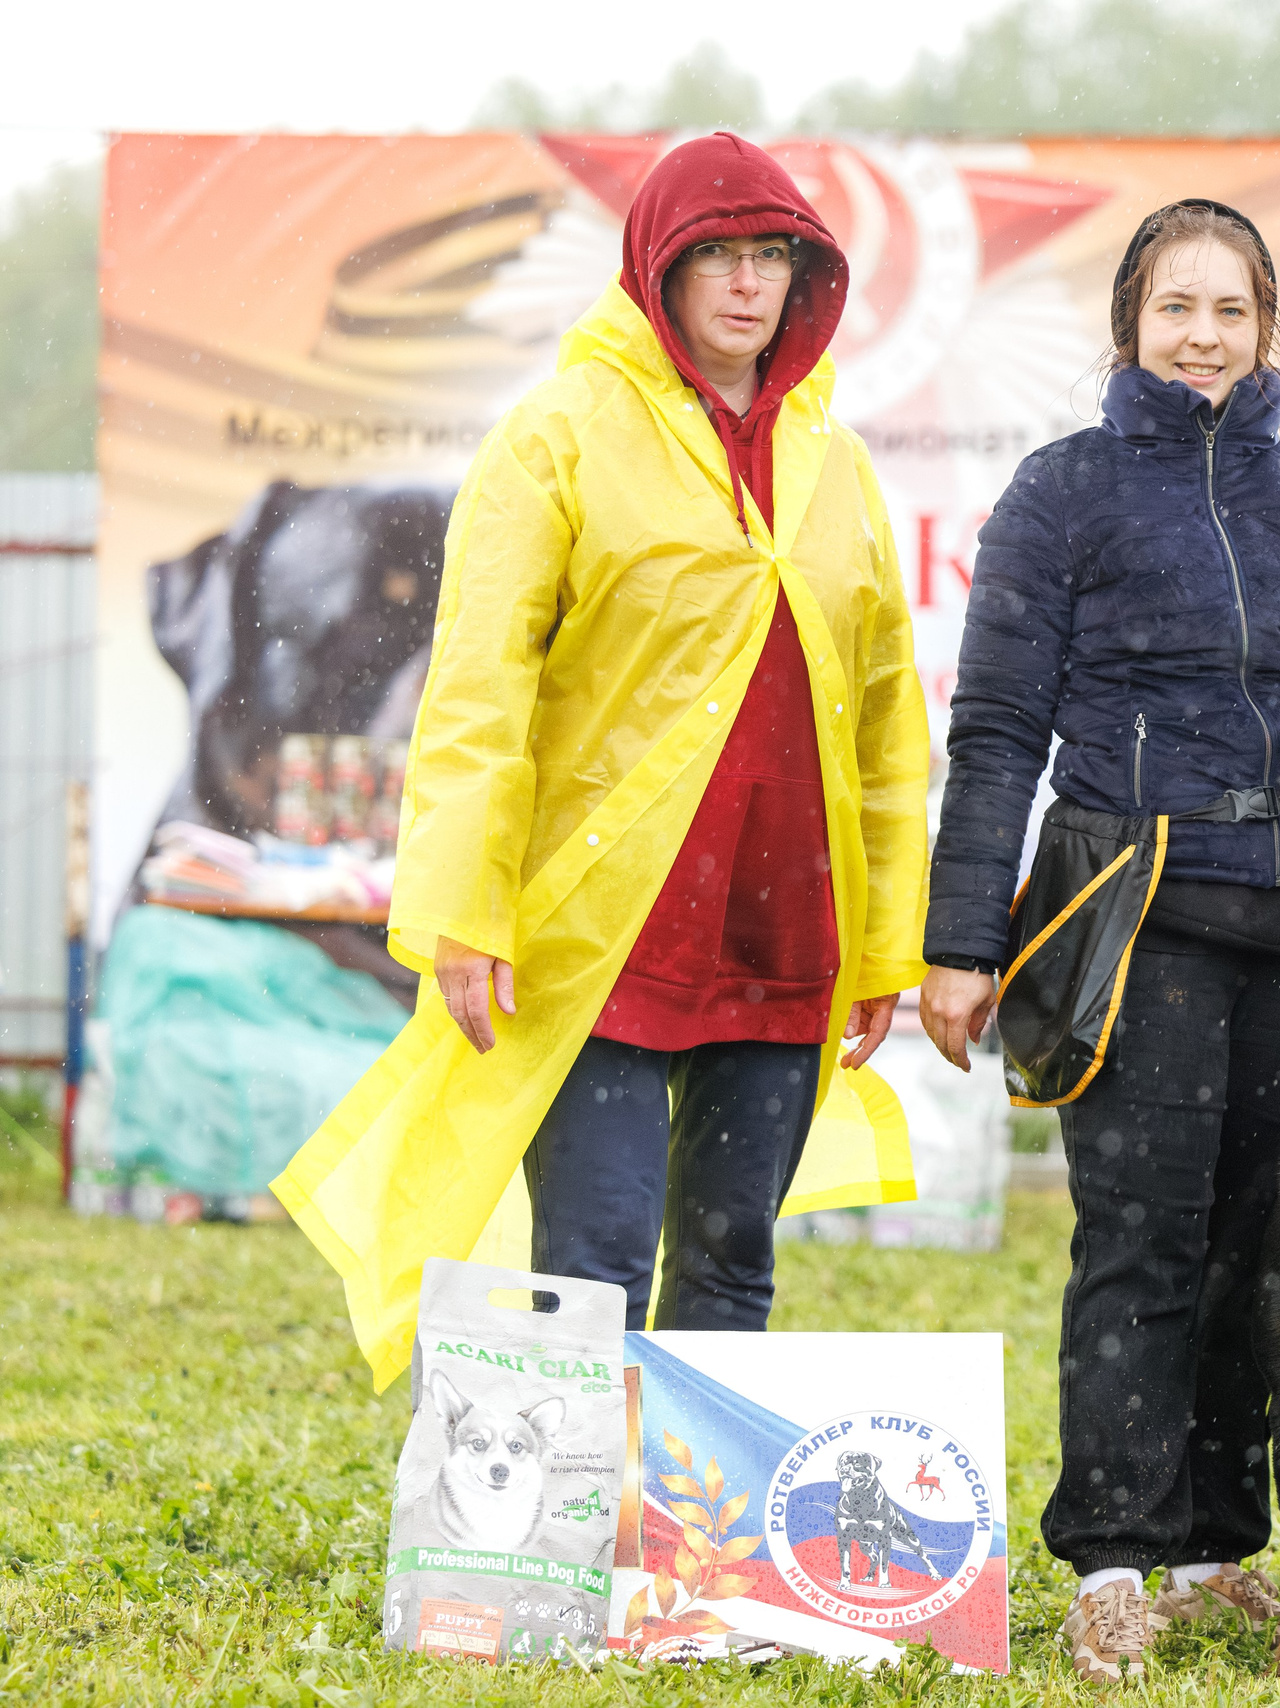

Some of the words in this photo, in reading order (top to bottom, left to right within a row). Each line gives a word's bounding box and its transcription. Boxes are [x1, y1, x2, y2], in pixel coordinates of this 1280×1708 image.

[434, 1341, 525, 1373] ACARI
[538, 1359, 612, 1381] CIAR
[580, 1381, 612, 1393] eco
[770, 1420, 854, 1532] РОТВЕЙЛЕР
[870, 1416, 934, 1440] КЛУБ
[942, 1441, 991, 1532] РОССИИ
[551, 1507, 589, 1519] organic
[591, 1506, 610, 1516] food
[563, 1496, 597, 1506] natural
[417, 1549, 509, 1572] Professional
[513, 1555, 544, 1576] Line
[547, 1562, 575, 1586] Dog
[579, 1570, 606, 1591] Food
[785, 1565, 956, 1626] НИЖЕГОРОДСКОЕ
[957, 1565, 979, 1590] РО
[435, 1612, 486, 1630] PUPPY
[572, 1608, 595, 1635] 3,5
